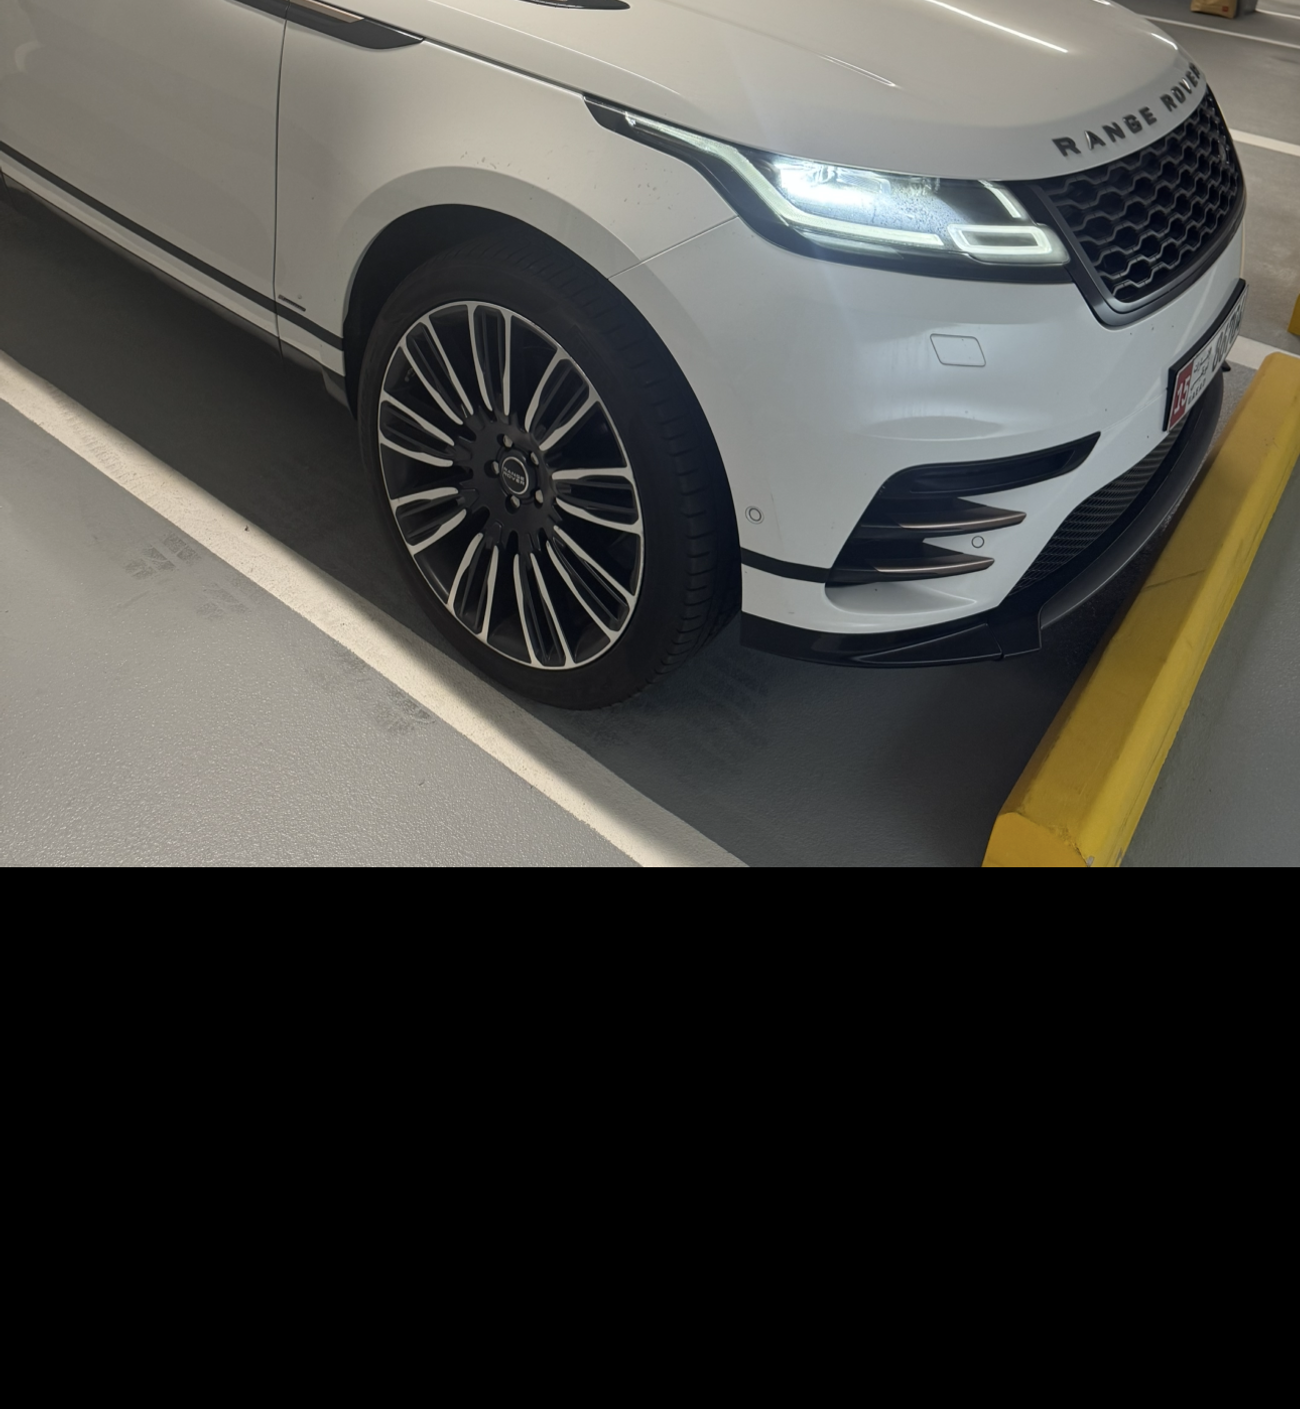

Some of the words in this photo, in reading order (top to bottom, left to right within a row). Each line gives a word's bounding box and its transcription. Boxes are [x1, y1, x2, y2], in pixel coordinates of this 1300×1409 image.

[1052, 106, 1157, 157] RANGE
[1160, 62, 1201, 112] ROVER
[1173, 375, 1191, 415] 15
